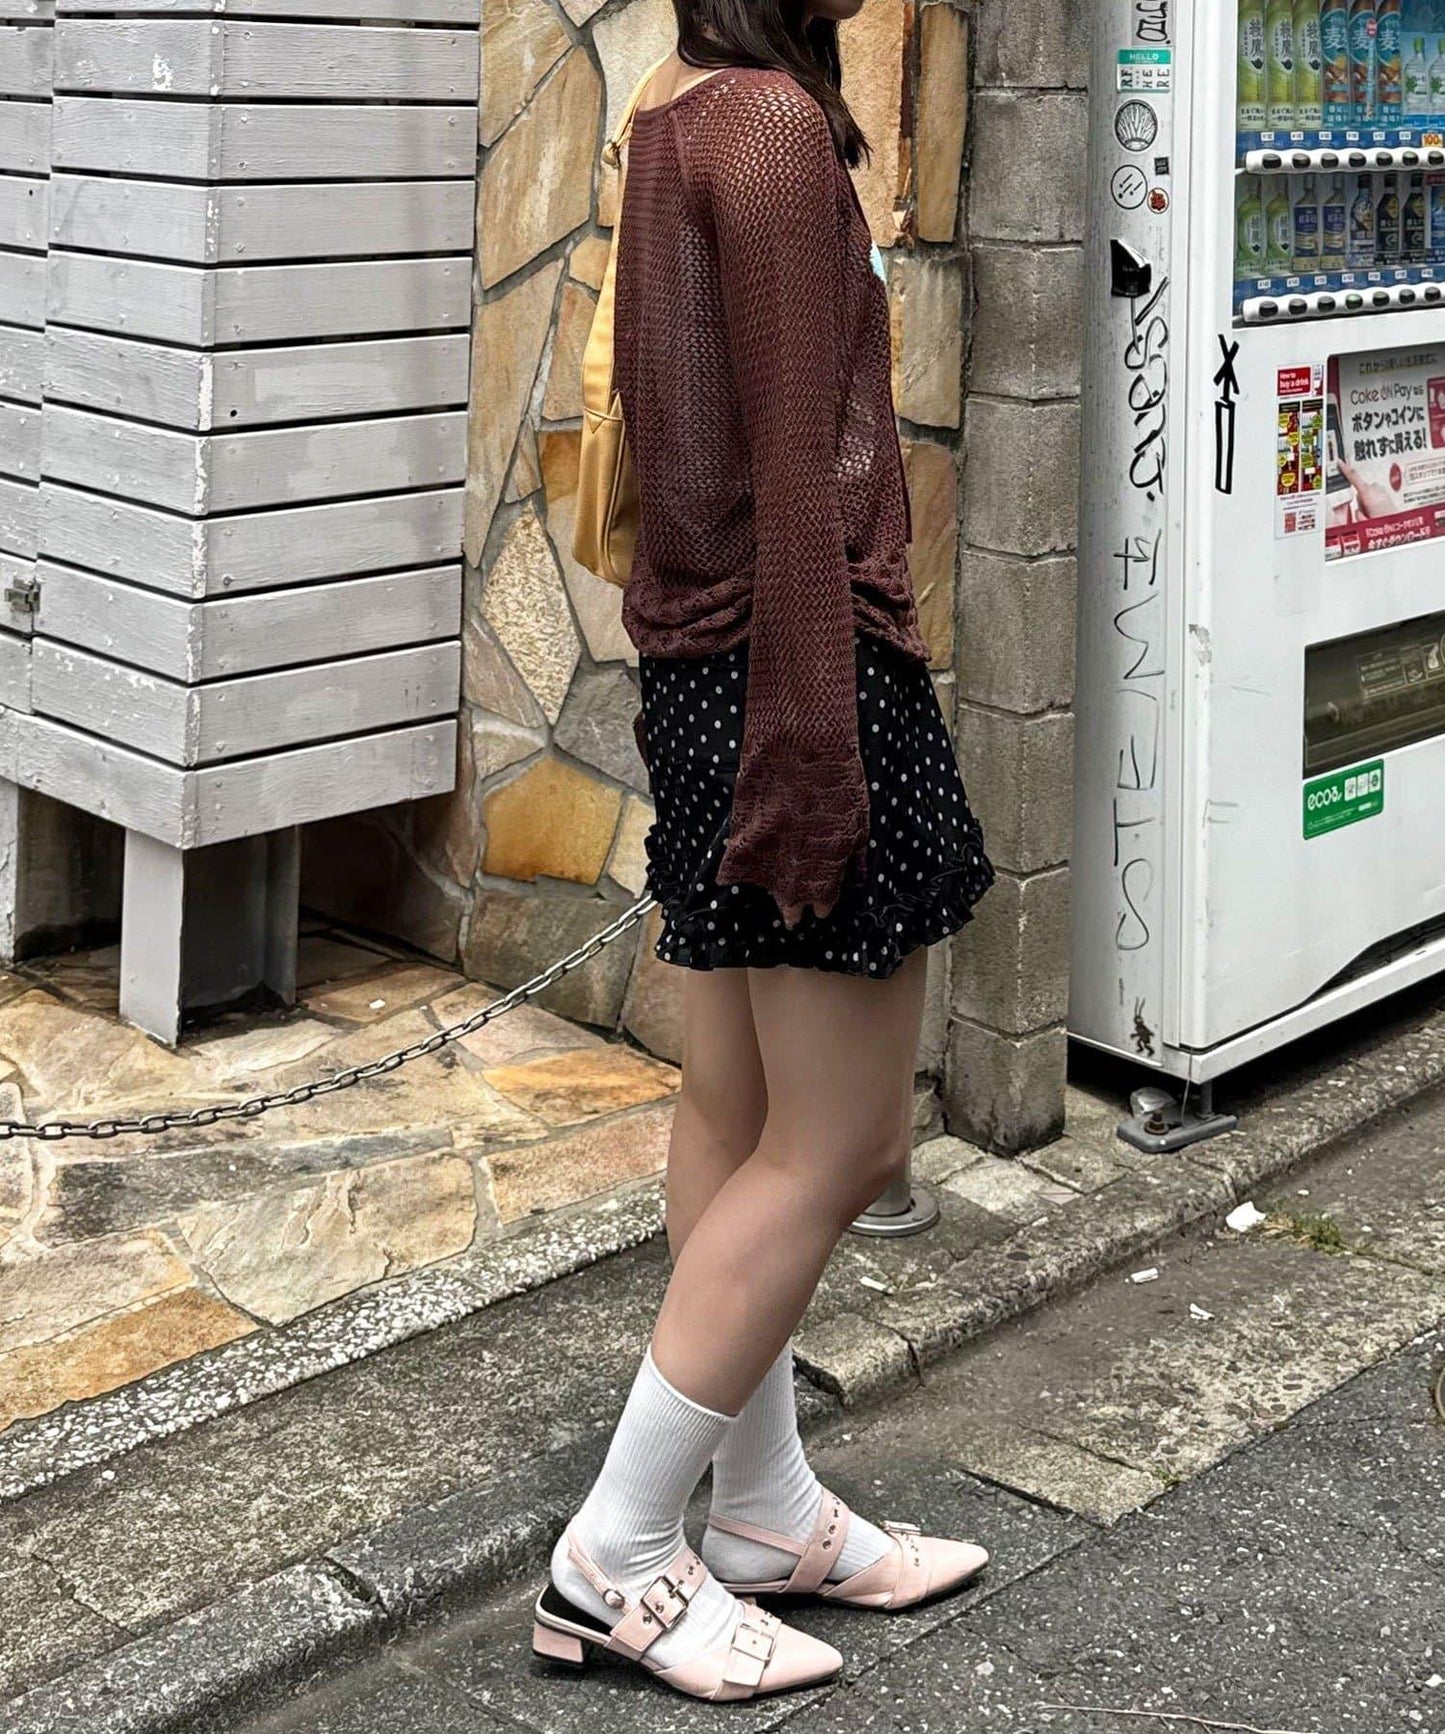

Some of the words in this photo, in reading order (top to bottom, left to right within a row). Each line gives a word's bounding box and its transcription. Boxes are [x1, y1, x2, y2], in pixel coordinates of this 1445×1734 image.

[1350, 385, 1379, 405] Coke
[1393, 383, 1412, 401] Pay
[1352, 405, 1425, 433] ボタンやコインに
